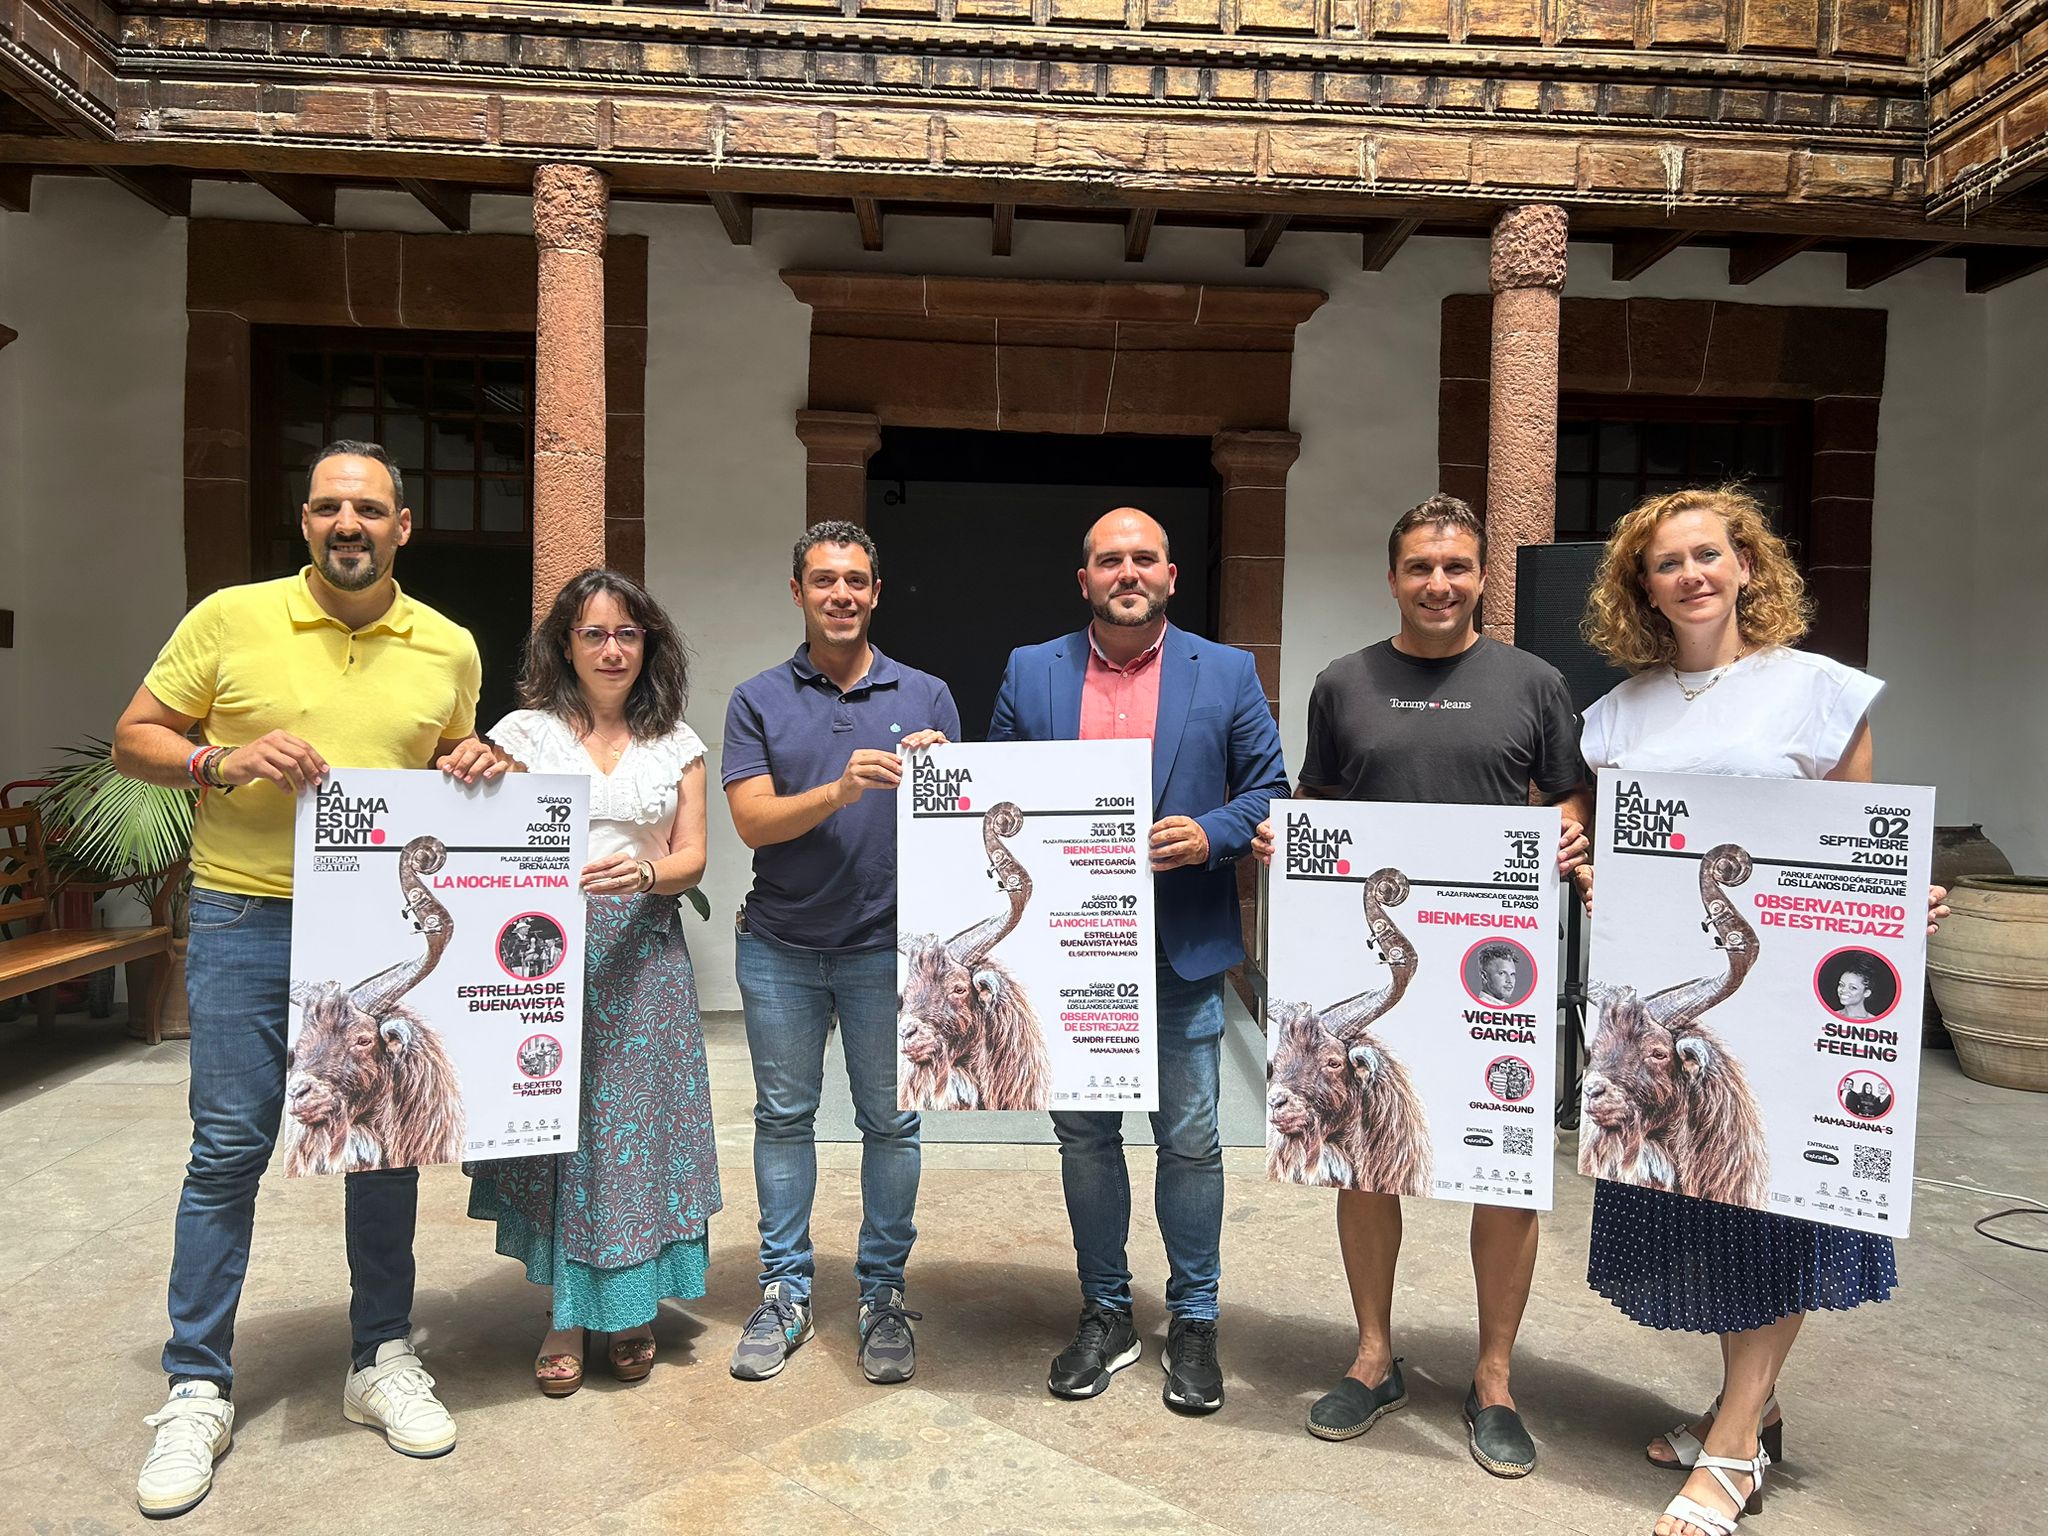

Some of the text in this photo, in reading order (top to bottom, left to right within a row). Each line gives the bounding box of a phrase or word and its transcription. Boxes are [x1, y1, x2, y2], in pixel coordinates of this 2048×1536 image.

[1390, 698, 1472, 710] Tommy Jeans
[913, 755, 935, 769] LA
[913, 769, 972, 783] PALMA
[317, 781, 344, 796] LA
[913, 783, 960, 797] ES UN
[1616, 780, 1643, 798] LA
[316, 797, 388, 813] PALMA
[537, 795, 572, 804] SÁBADO
[1095, 797, 1135, 807] 21.00 H
[545, 805, 571, 822] 19
[1615, 797, 1689, 817] PALMA
[1864, 804, 1910, 817] SÁBADO
[316, 813, 373, 828] ES UN
[1287, 812, 1311, 828] LA
[1614, 813, 1673, 832] ES UN
[526, 823, 570, 832] AGOSTO
[1117, 823, 1136, 836] 13
[1869, 817, 1909, 840] 02
[528, 835, 570, 845] 21.00 H
[1287, 828, 1353, 844] PALMA
[1504, 831, 1540, 839] JUEVES
[1063, 845, 1136, 854] BIENMESUENA
[1511, 840, 1539, 859] 13
[1819, 835, 1909, 851] SEPTIEMBRE
[544, 854, 570, 862] ÁLAMOS
[1287, 843, 1339, 859] ES UN
[1105, 857, 1136, 866] GARCÍA
[1504, 859, 1539, 869] JULIO
[1851, 852, 1908, 867] 21.00 H
[433, 875, 569, 888] LA NOCHE LATINA
[1493, 871, 1538, 883] 21.00 H
[1781, 870, 1907, 887] PARQUE ANTONIO GÓMEZ FELIPE
[1778, 877, 1906, 897] LOS LLANOS DE ARIDANE
[1081, 895, 1137, 909] AGOSTO 19
[1513, 901, 1538, 909] PASO
[1754, 893, 1905, 921] OBSERVATORIO
[1050, 918, 1137, 927] LA NOCHE LATINA
[1418, 911, 1538, 930] BIENMESUENA
[1761, 911, 1904, 939] DE ESTREJAZZ
[1084, 931, 1125, 939] ESTRELLA
[1060, 939, 1112, 947] BUENAVISTA
[458, 982, 565, 998] ESTRELLAS DE
[1060, 983, 1139, 997] SEPTIEMBRE 02
[469, 997, 565, 1012] BUENAVISTA
[520, 1008, 564, 1024] Y MÁS
[1060, 1012, 1139, 1021] OBSERVATORIO
[1464, 1010, 1536, 1028] VICENTE
[1065, 1023, 1139, 1031] DE ESTREJAZZ
[1824, 1022, 1898, 1045] SUNDRI
[1470, 1027, 1536, 1044] GARCÍA
[1817, 1038, 1898, 1062] FEELING
[524, 1080, 562, 1089] SEXTETO
[522, 1088, 562, 1097] PALMERO
[1470, 1101, 1534, 1114] GRAJA SOUND
[1807, 1140, 1839, 1151] ENTRADAS
